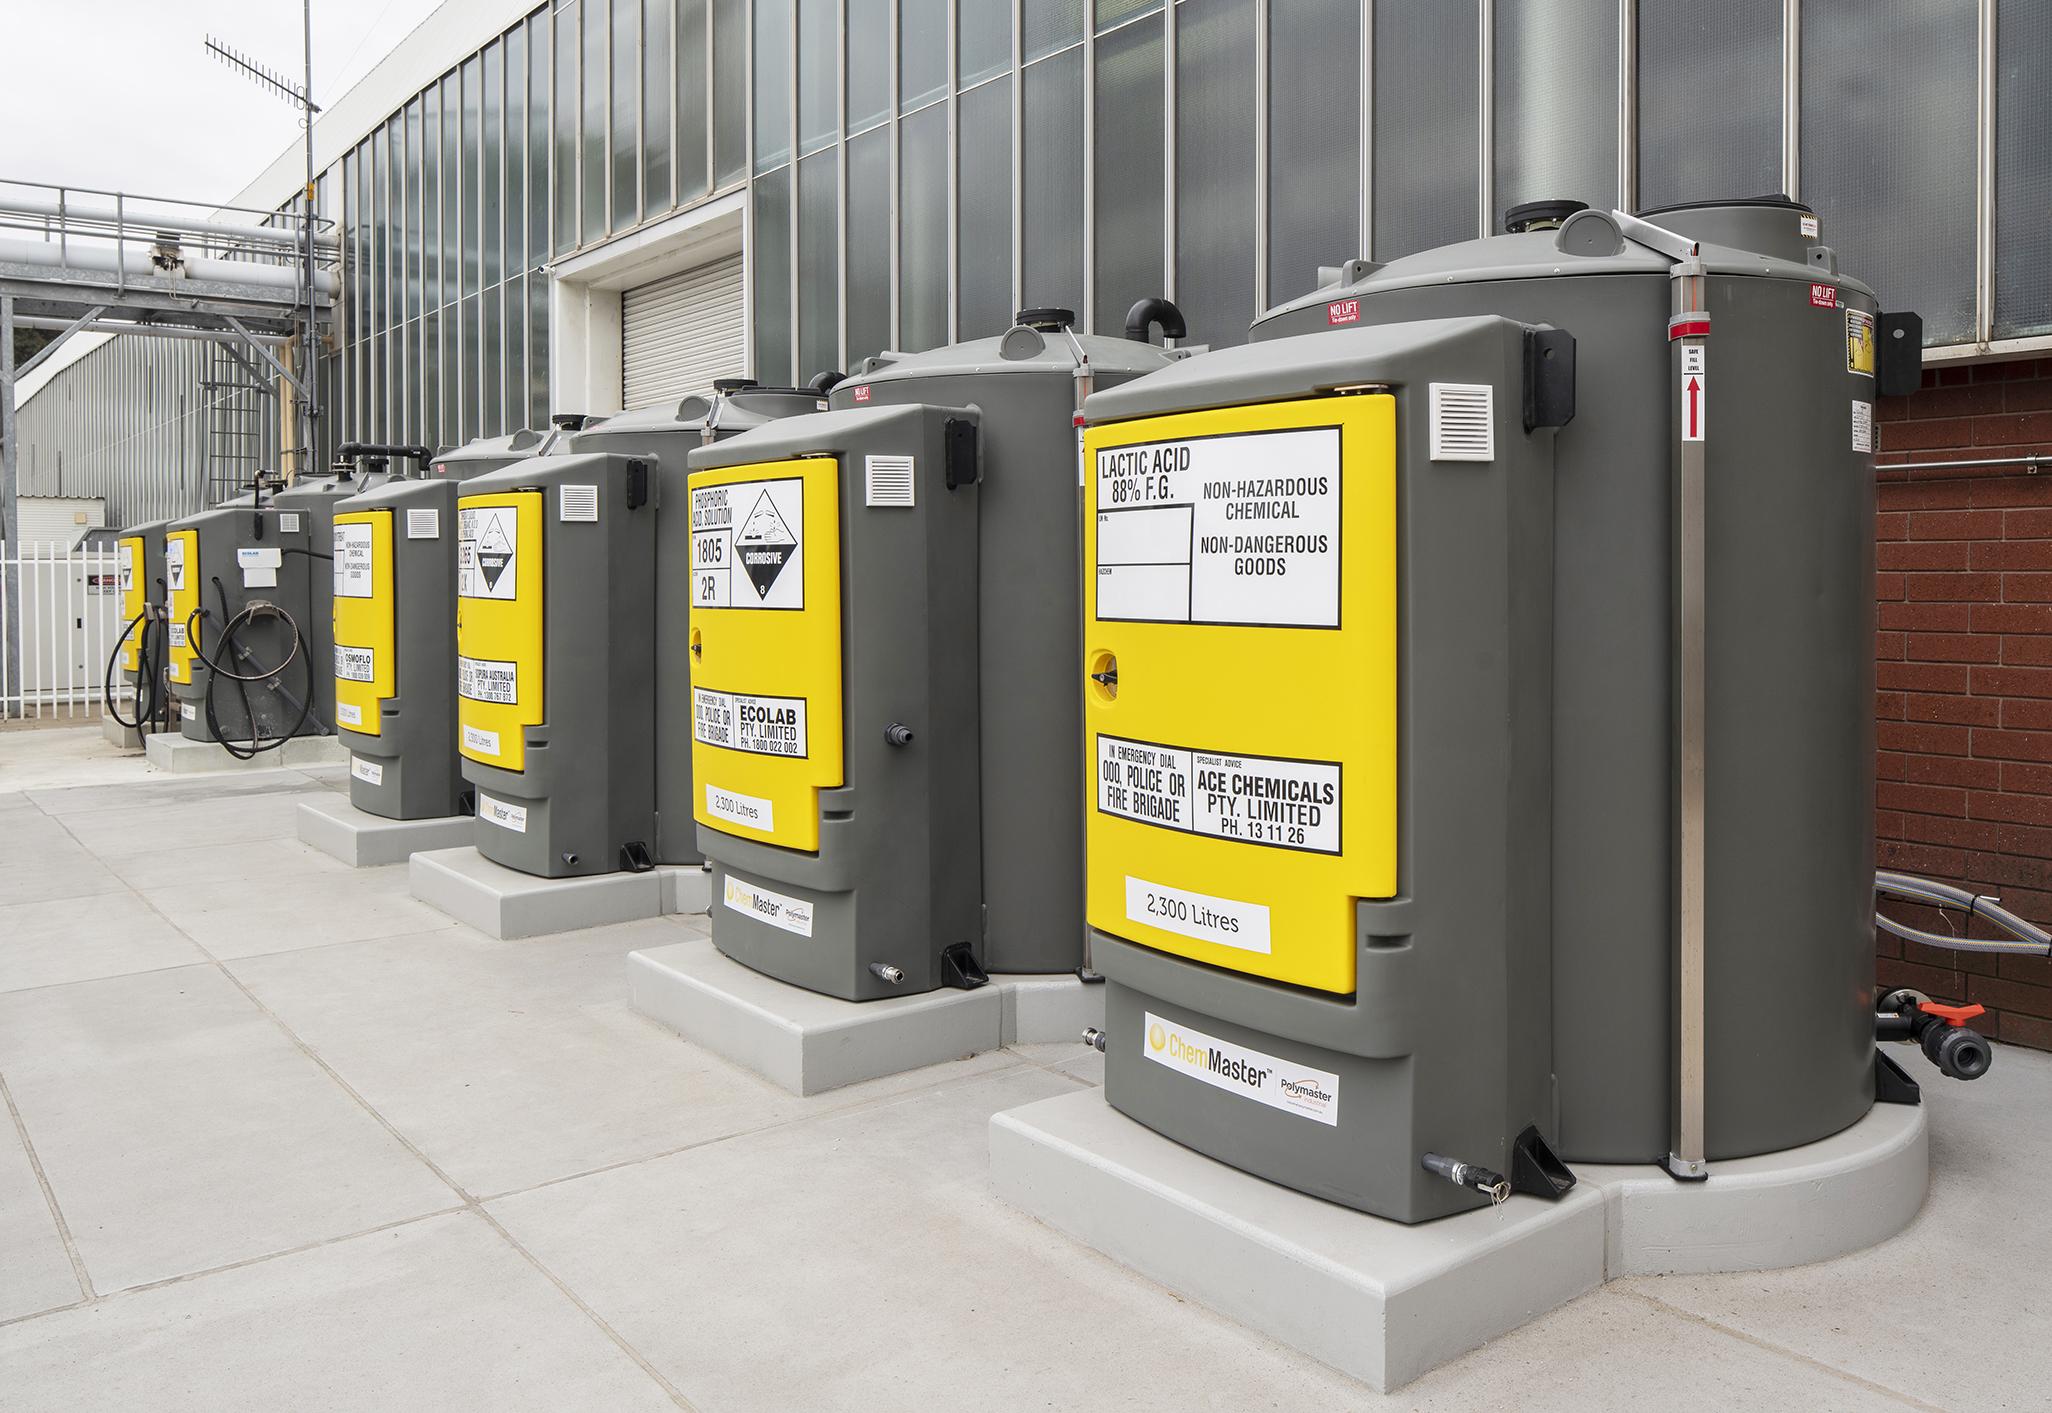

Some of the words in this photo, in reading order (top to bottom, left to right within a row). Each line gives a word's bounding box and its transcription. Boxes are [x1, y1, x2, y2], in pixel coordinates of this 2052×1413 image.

[1812, 285, 1823, 298] NO
[1822, 286, 1835, 300] LIFT
[1330, 303, 1341, 316] NO
[1341, 301, 1358, 314] LIFT
[1102, 449, 1148, 479] LACTIC
[1152, 446, 1191, 474] ACID
[1112, 478, 1141, 503] 88%
[1145, 475, 1175, 500] F.G.
[1203, 477, 1329, 500] NON-HAZARDOUS
[694, 489, 729, 510] PHOSPHORIC
[704, 507, 733, 526] SOLUTION
[1225, 501, 1300, 520] CHEMICAL
[697, 537, 722, 563] 1805
[1200, 535, 1329, 554] NON-DANGEROUS
[745, 551, 782, 565] CORROSIVE
[1234, 557, 1287, 577] GOODS
[701, 575, 716, 601] 2R
[759, 585, 766, 595] 8
[345, 653, 371, 664] OSMOFLO
[489, 670, 515, 682] AUSTRALIA
[488, 681, 511, 693] LIMITED
[705, 706, 721, 724] POLICE
[722, 710, 731, 727] OR
[740, 704, 796, 725] ECOLAB
[708, 724, 729, 743] BRIGADE
[740, 722, 757, 738] PTY.
[759, 725, 797, 741] LIMITED
[740, 737, 752, 749] PH.
[752, 739, 768, 751] 1800
[769, 740, 782, 753] 022
[783, 742, 798, 754] 002
[1108, 744, 1116, 758] IN
[1117, 746, 1157, 766] EMERGENCY
[1160, 754, 1176, 769] DIAL
[1196, 755, 1222, 766] SPECIALIST
[1224, 760, 1242, 769] ADVICE
[1127, 764, 1163, 793] POLICE
[1169, 772, 1186, 798] OR
[1197, 770, 1227, 793] ACE
[1231, 773, 1334, 805] CHEMICALS
[735, 800, 759, 819] Litres
[1107, 785, 1128, 811] FIRE
[1132, 791, 1180, 823] BRIGADE
[1207, 793, 1241, 818] PTY.
[1247, 798, 1321, 827] LIMITED
[1221, 817, 1243, 836] PH.
[1247, 822, 1263, 839] 13
[1267, 824, 1282, 842] 11
[1287, 826, 1305, 845] 26
[1146, 892, 1188, 922] 2,300
[1191, 904, 1240, 933] Litres
[1281, 1078, 1332, 1102] Polymaster
